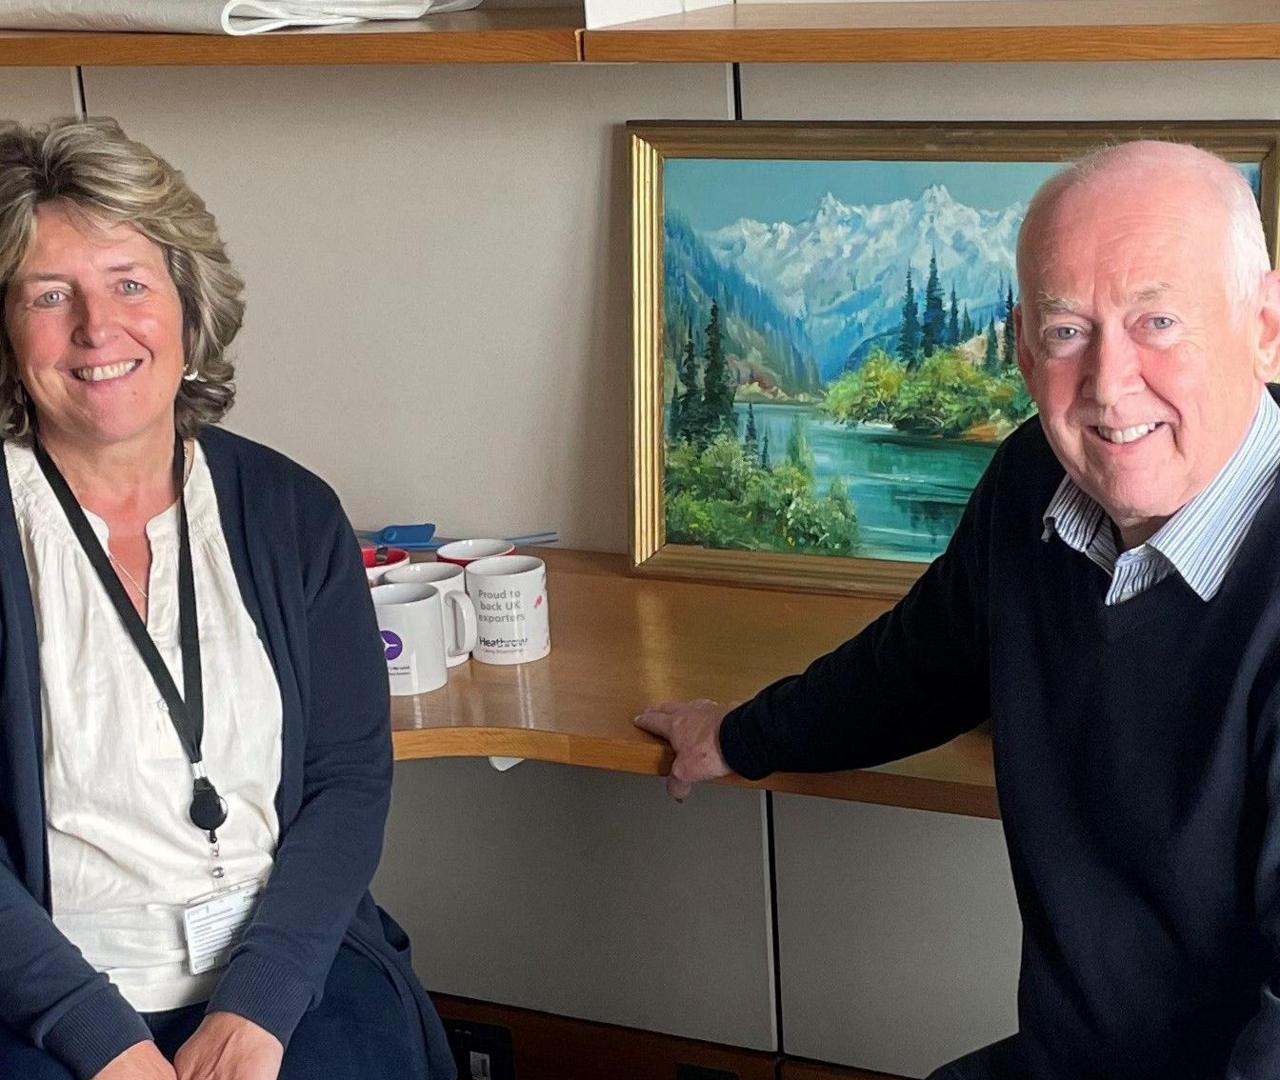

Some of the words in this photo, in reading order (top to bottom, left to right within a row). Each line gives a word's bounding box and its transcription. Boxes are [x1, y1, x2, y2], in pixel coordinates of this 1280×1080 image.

[478, 589, 507, 599] Proud
[510, 590, 521, 598] to
[480, 602, 502, 611] back
[505, 602, 521, 611] UK
[478, 614, 526, 623] exporters
